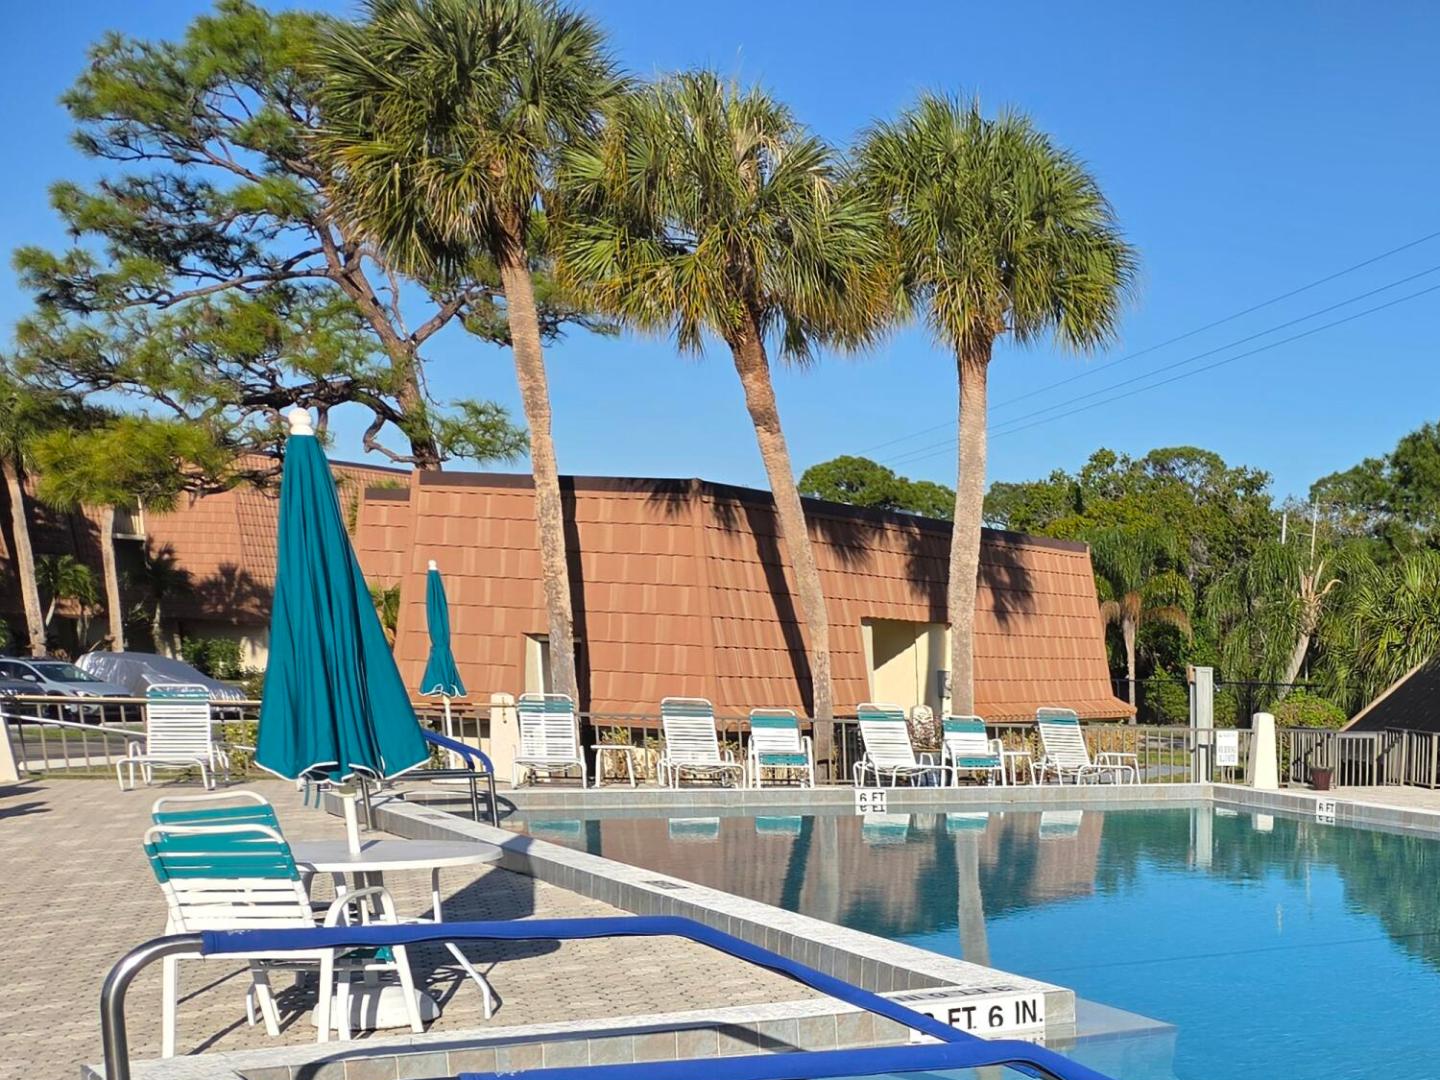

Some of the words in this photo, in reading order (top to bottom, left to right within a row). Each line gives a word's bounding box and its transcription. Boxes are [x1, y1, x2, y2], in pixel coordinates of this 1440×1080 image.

[872, 792, 885, 802] FT
[988, 1005, 1004, 1028] 6
[1015, 999, 1044, 1025] IN.
